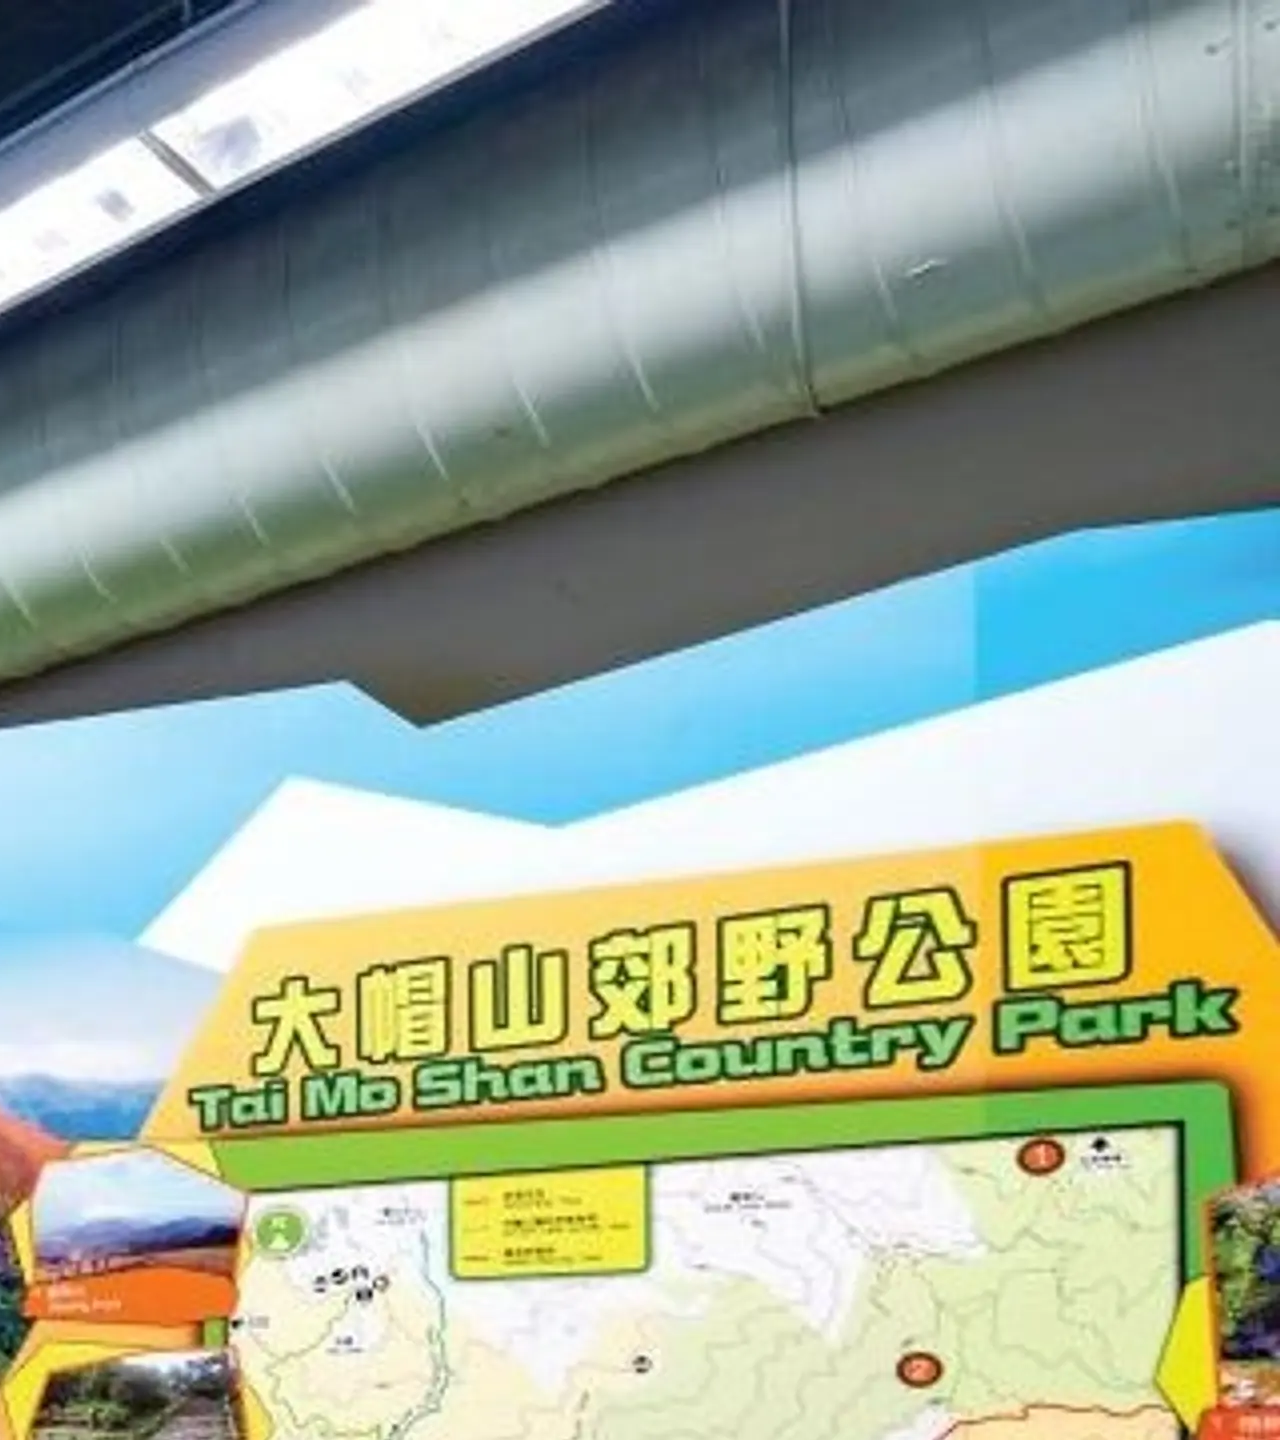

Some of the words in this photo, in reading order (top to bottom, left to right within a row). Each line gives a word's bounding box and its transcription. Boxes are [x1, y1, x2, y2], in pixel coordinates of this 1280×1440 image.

[190, 1075, 288, 1130] Tai
[301, 1071, 402, 1120] Mo
[413, 1055, 605, 1110] Shan
[622, 1015, 976, 1090] Country
[992, 979, 1240, 1056] Park
[251, 860, 1132, 1078] 大帽山郊野公園
